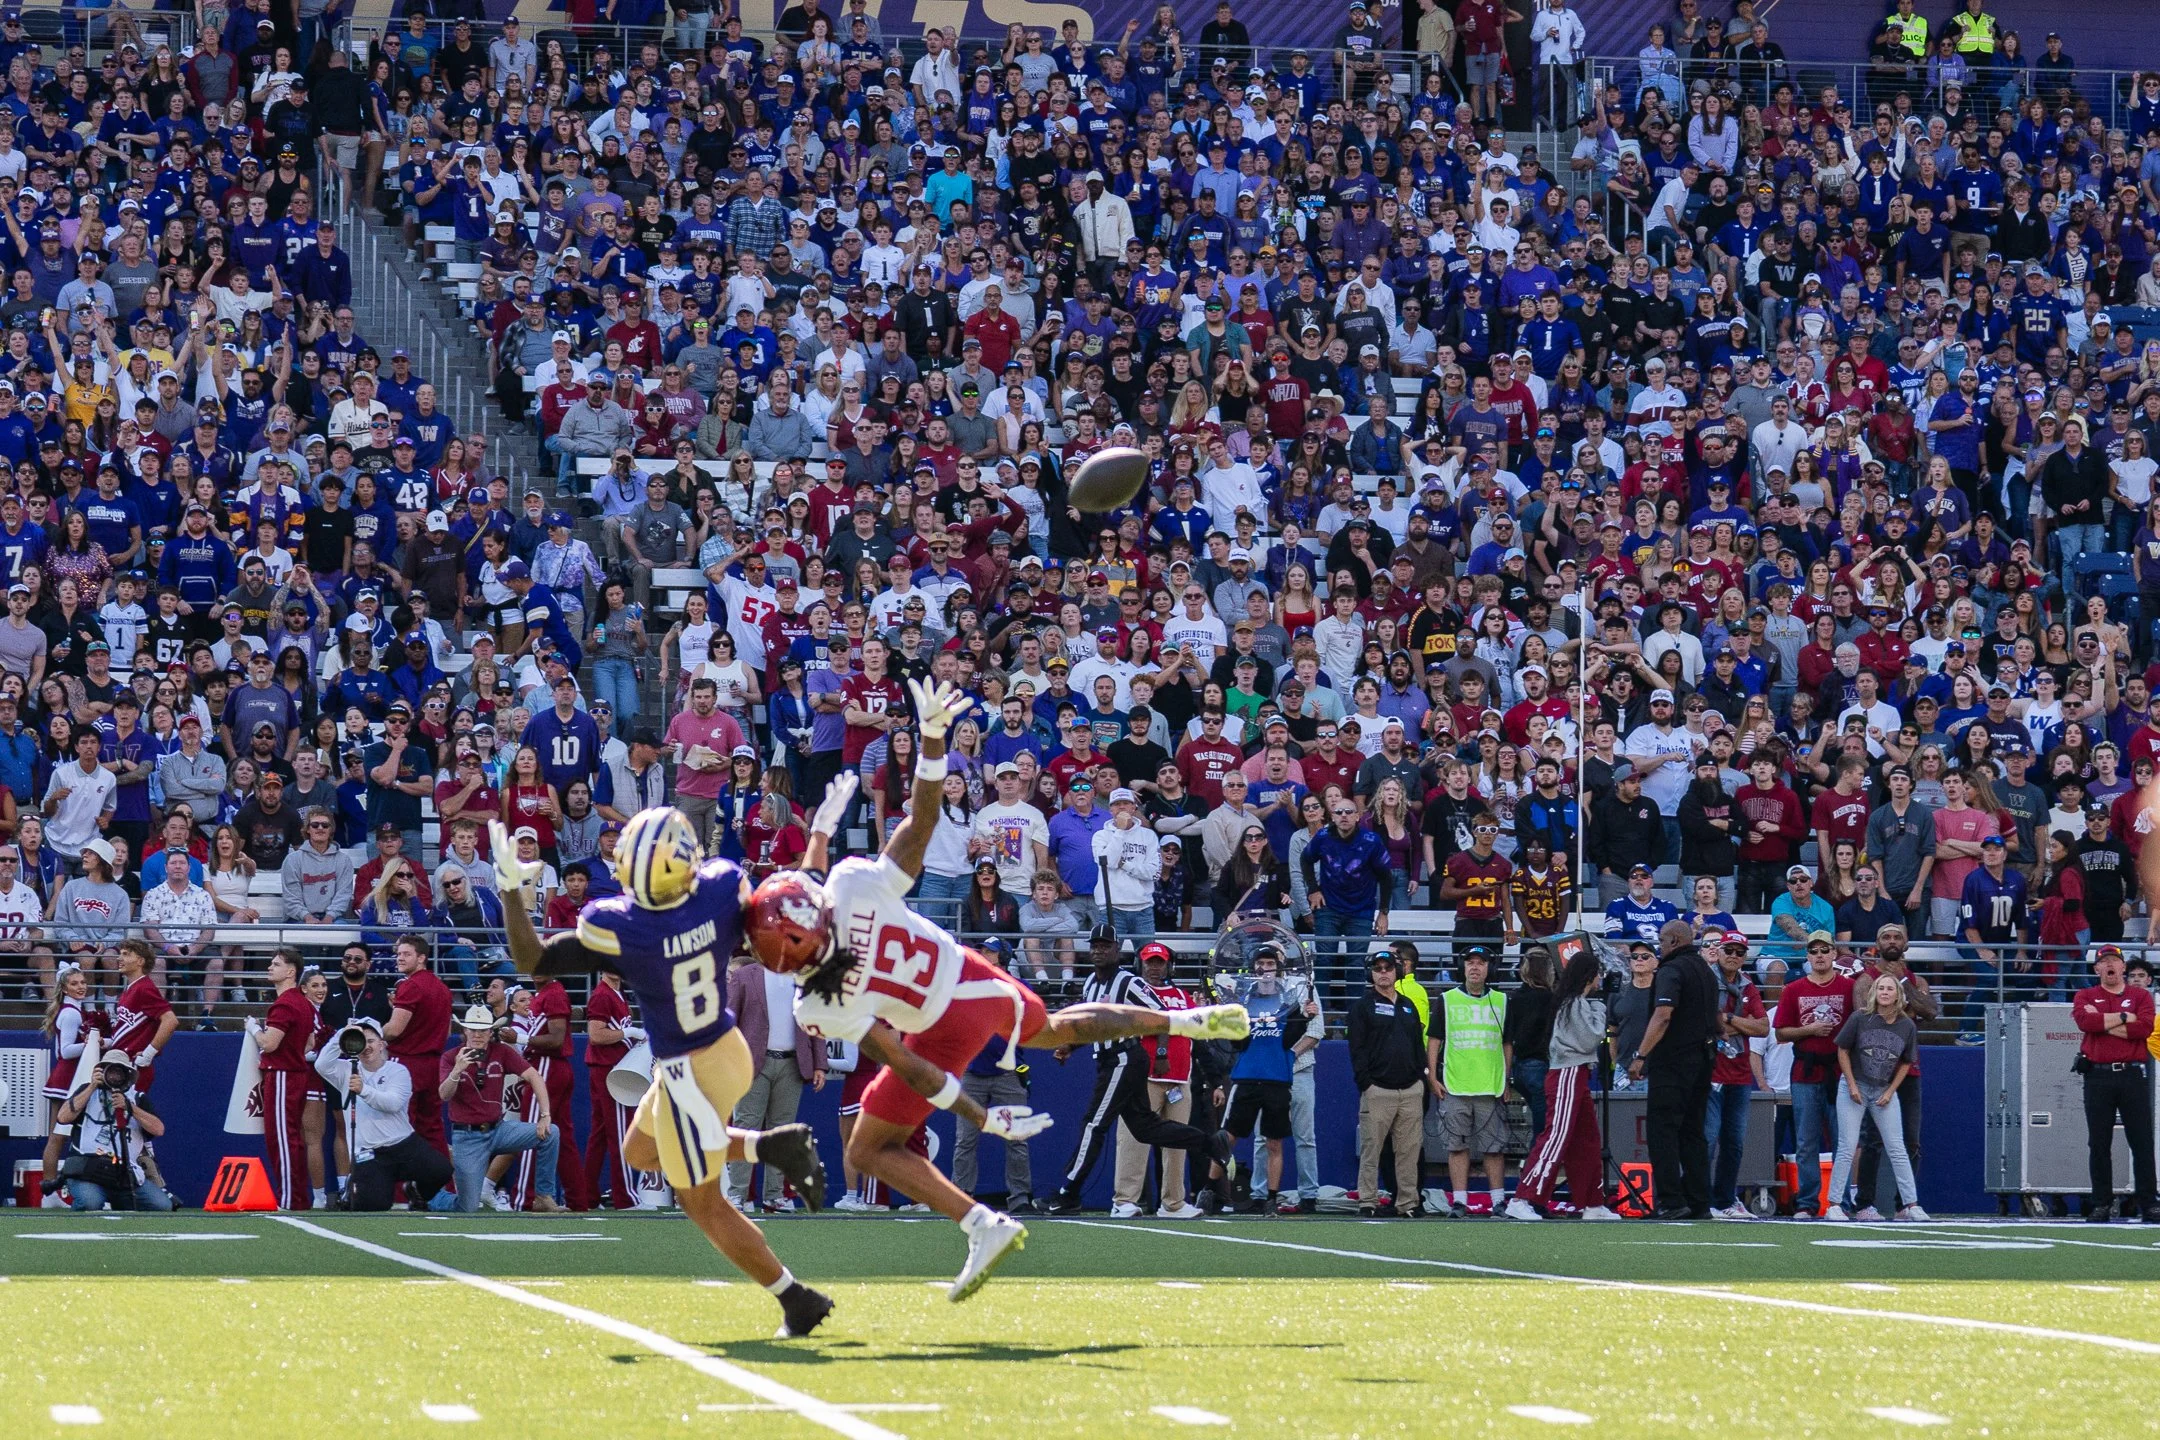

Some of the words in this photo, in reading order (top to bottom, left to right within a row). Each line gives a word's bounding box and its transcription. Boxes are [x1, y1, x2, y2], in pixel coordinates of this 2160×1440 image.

[1068, 75, 1087, 88] W
[1874, 180, 1881, 204] 1
[1967, 188, 1980, 208] 9
[469, 198, 478, 217] 1
[1238, 227, 1255, 237] W
[1743, 239, 1750, 257] 1
[1775, 266, 1796, 281] W
[693, 282, 714, 290] HUSKY
[924, 307, 933, 327] 1
[2024, 308, 2050, 331] 25
[1544, 331, 1552, 350] 1
[1983, 327, 1989, 341] 1
[1268, 384, 1300, 401] WAZZU
[417, 425, 439, 441] W
[396, 484, 428, 508] 42
[88, 510, 126, 518] CHAMPIONS
[5, 547, 23, 576] 7
[244, 609, 270, 618] USKIES
[742, 596, 776, 624] 52
[1812, 605, 1833, 613] WSU
[114, 628, 124, 649] 1
[1174, 630, 1214, 640] WASHINGTON
[157, 639, 184, 662] 67
[866, 697, 887, 714] 12
[1616, 708, 1625, 732] 1
[2030, 716, 2052, 730] W
[552, 736, 580, 766] 10
[1193, 751, 1236, 765] WASHINGTON
[1205, 770, 1224, 780] STATE
[2008, 793, 2026, 807] W
[988, 817, 1030, 827] WASHINGTON
[1010, 829, 1020, 839] W
[672, 829, 696, 862] W
[74, 898, 112, 920] Cougars
[1528, 899, 1555, 920] 26
[1626, 912, 1664, 922] WASHINGTON
[1962, 904, 1972, 918] 10
[1991, 896, 2011, 927] 10
[663, 919, 716, 958] LAWSON
[864, 924, 939, 1009] 13
[670, 956, 722, 1035] 8
[667, 1063, 683, 1080] W
[219, 1164, 246, 1203] 10
[1627, 1170, 1649, 1209] 2
